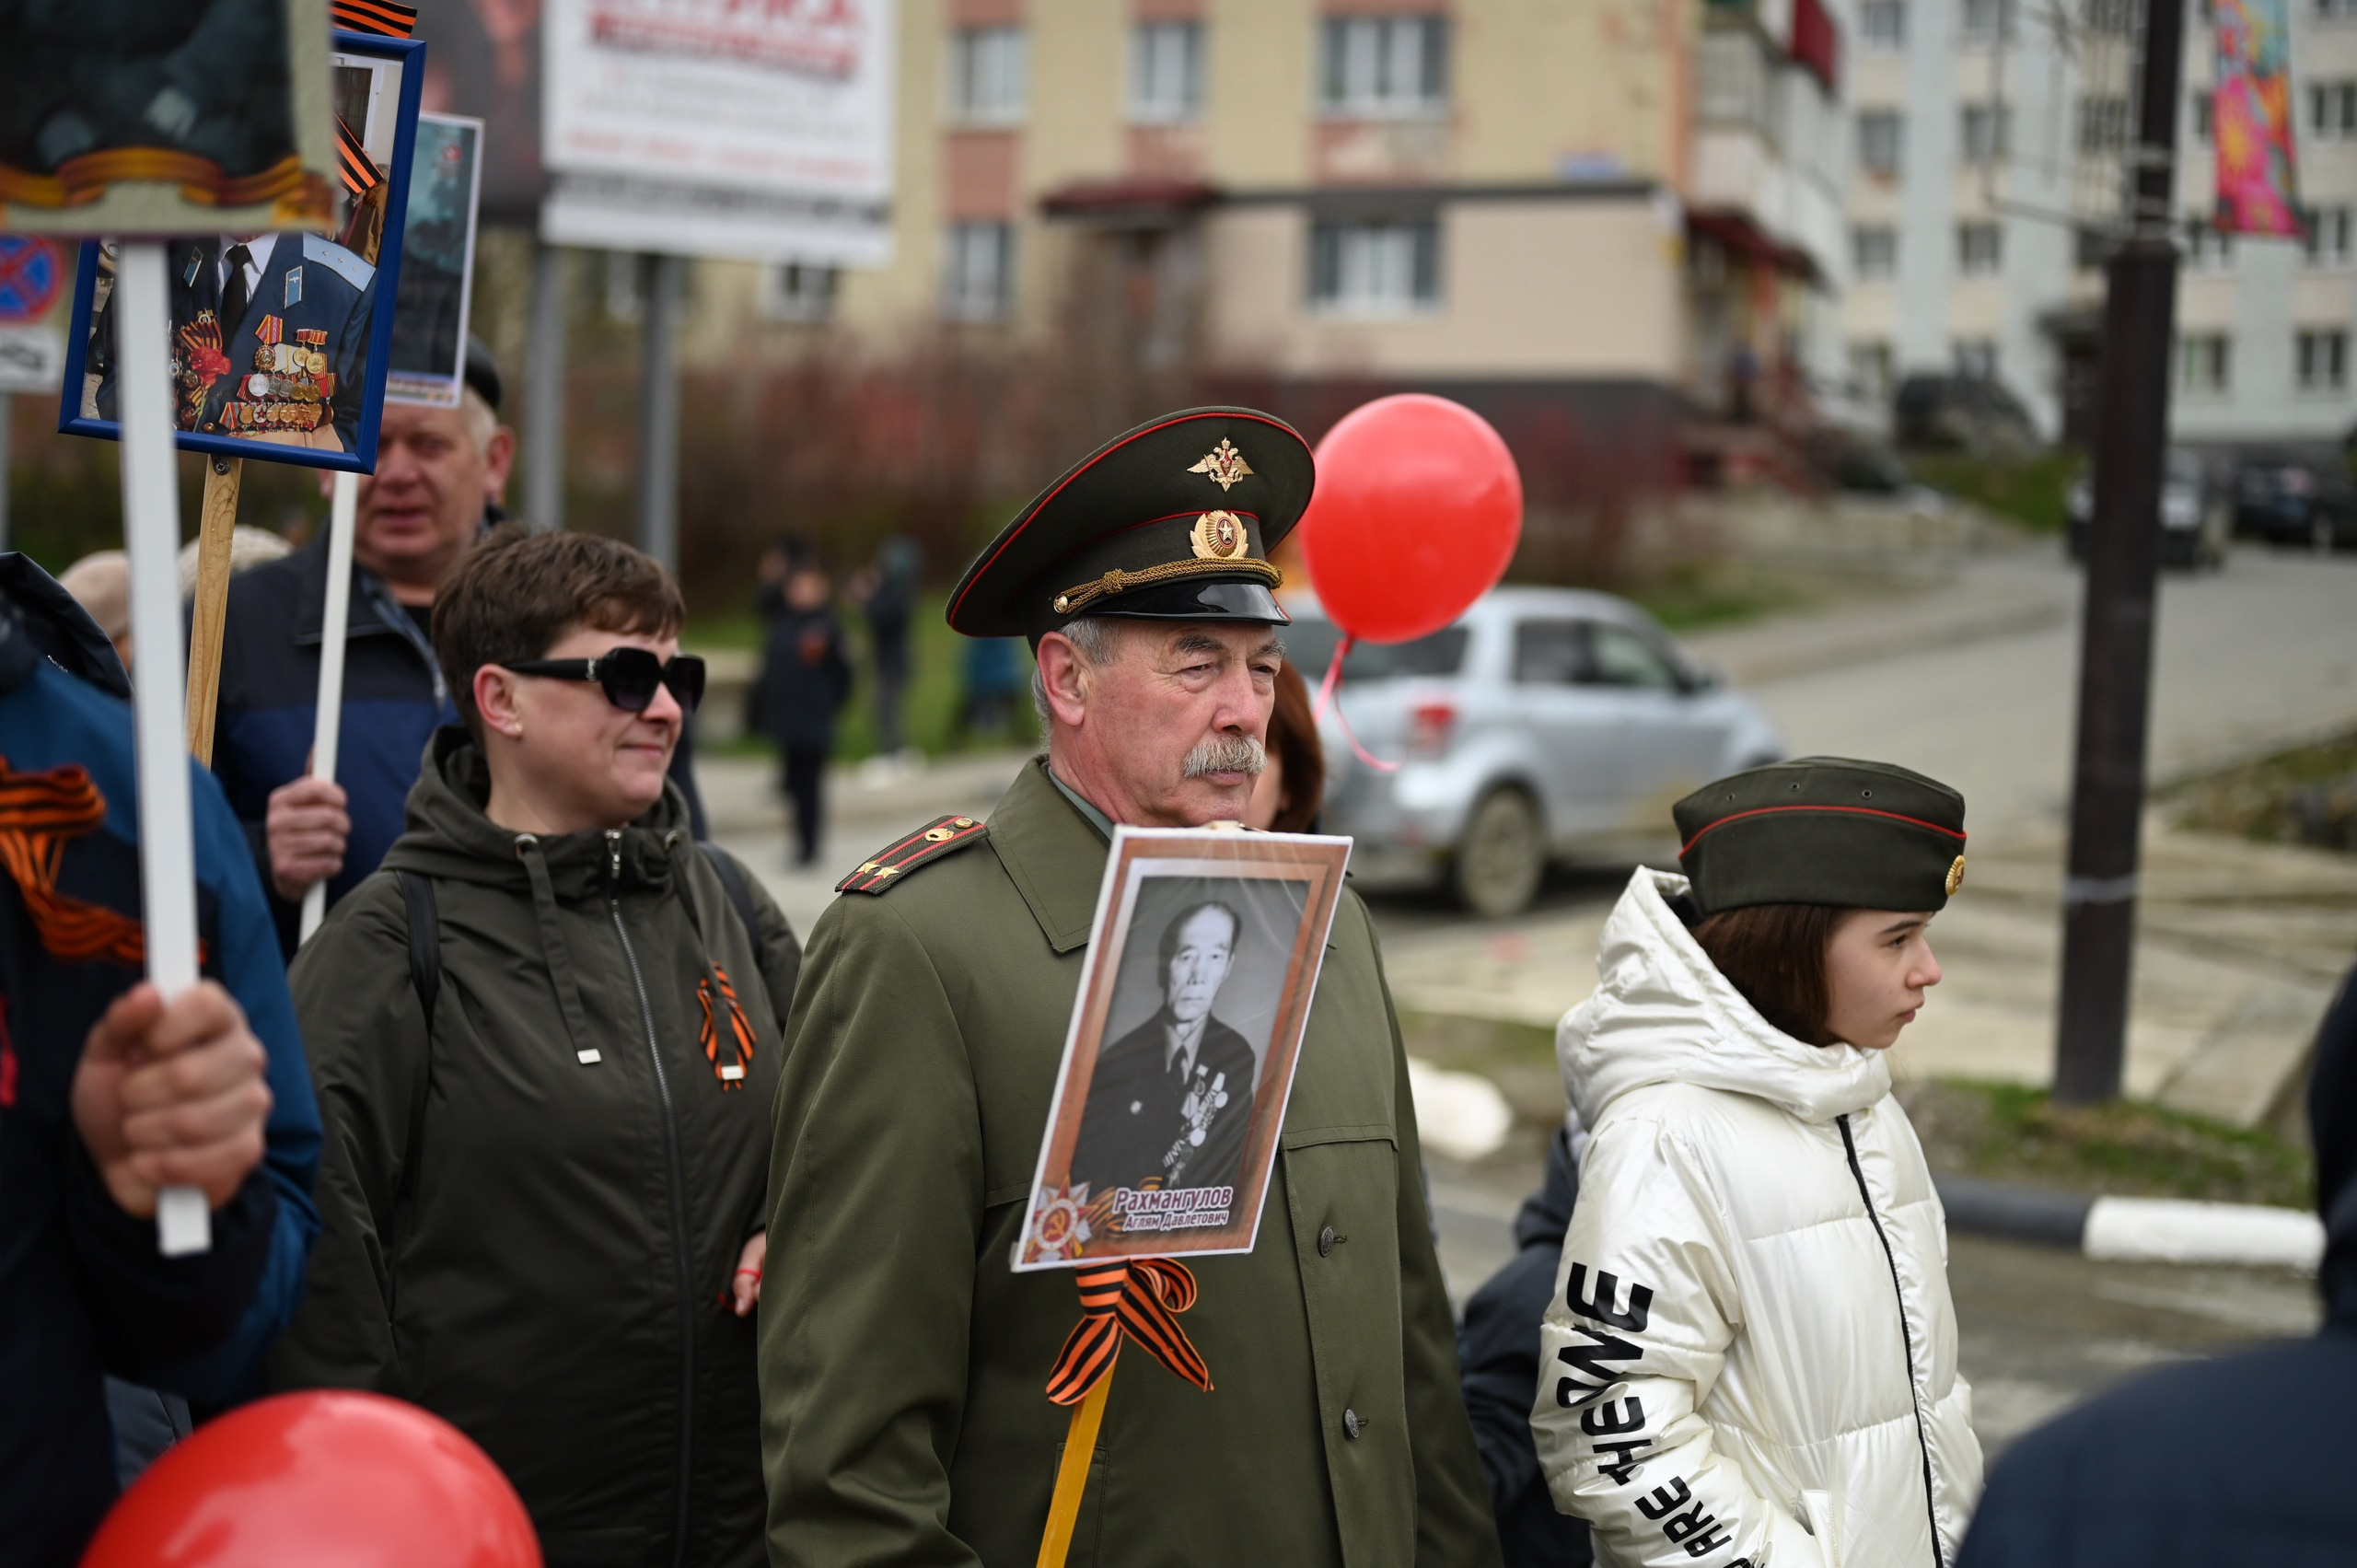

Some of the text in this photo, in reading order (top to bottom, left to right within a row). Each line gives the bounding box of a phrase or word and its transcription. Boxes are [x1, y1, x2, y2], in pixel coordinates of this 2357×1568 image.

[1113, 1188, 1232, 1213] Рахмангулов
[1123, 1212, 1229, 1230] Аглям Давлетович
[1633, 1475, 1733, 1558] ARE
